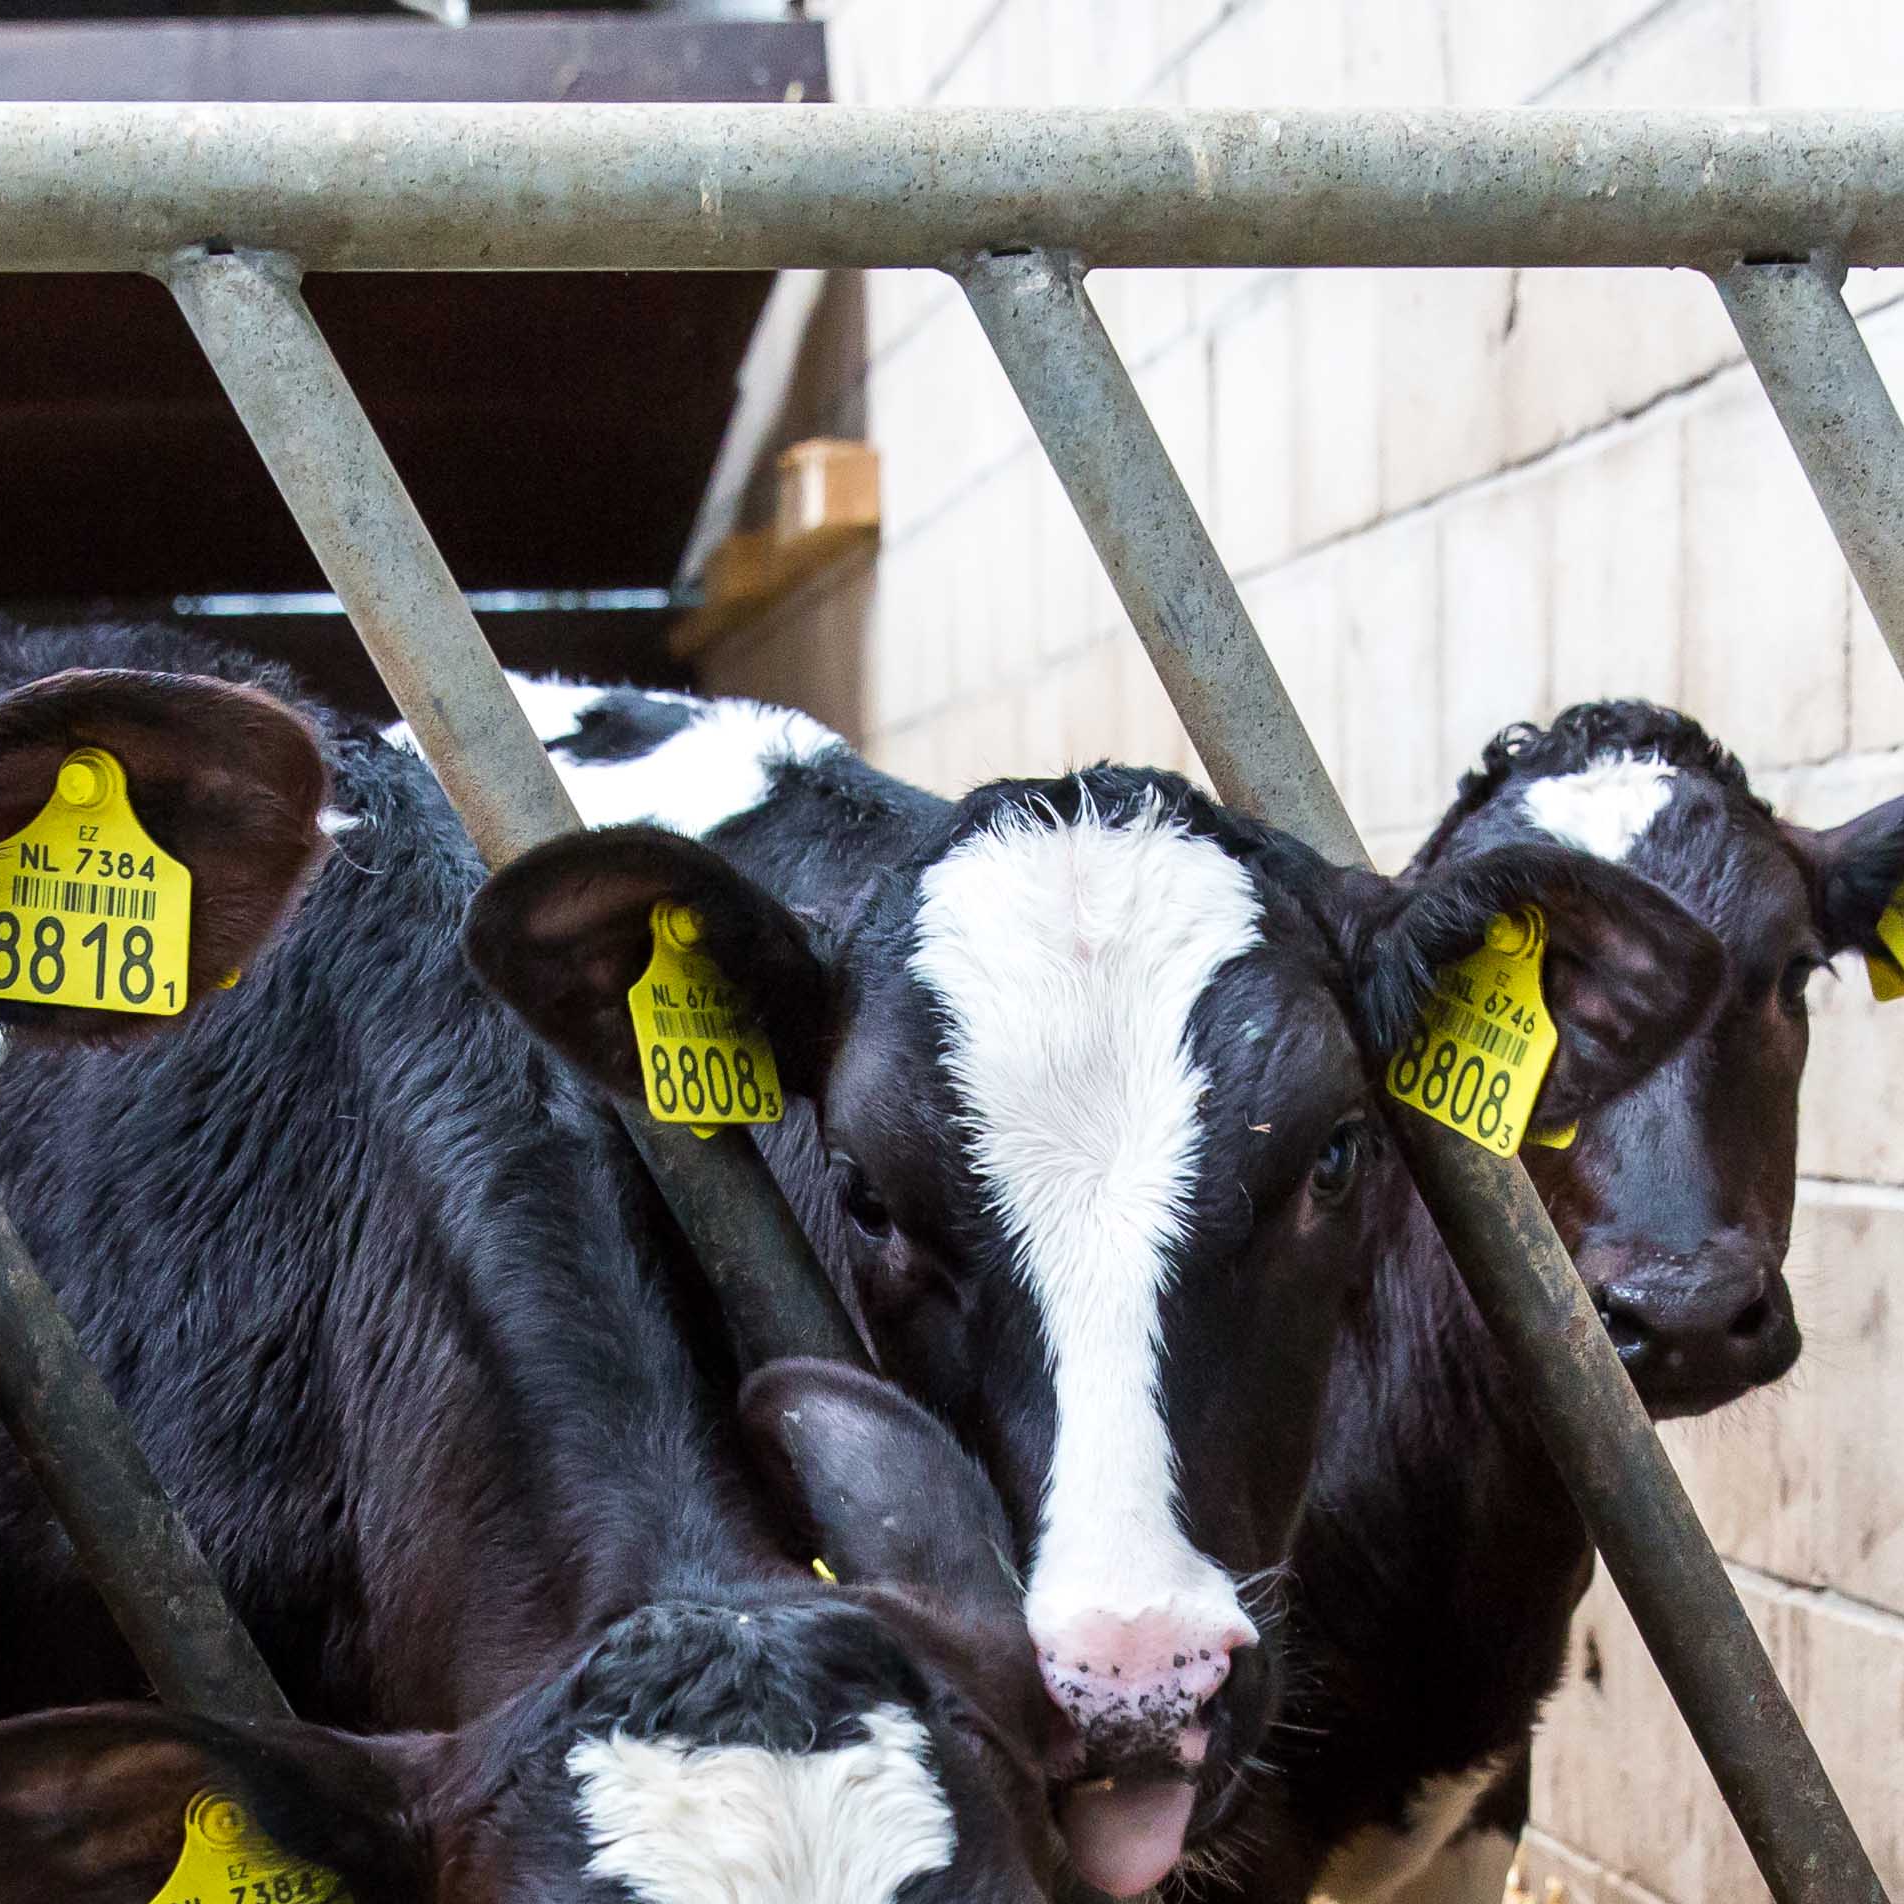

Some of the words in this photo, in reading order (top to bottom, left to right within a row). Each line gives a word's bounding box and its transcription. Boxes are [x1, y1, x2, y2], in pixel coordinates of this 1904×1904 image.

[78, 824, 99, 842] EZ
[19, 843, 60, 872] NL
[75, 848, 156, 882] 7384
[163, 981, 176, 1008] 1
[651, 983, 679, 1009] NL
[1484, 992, 1538, 1035] 6746
[651, 1044, 762, 1117] 8808
[1393, 1028, 1511, 1139] 8808
[1498, 1124, 1514, 1150] 3
[227, 1862, 249, 1881] EZ
